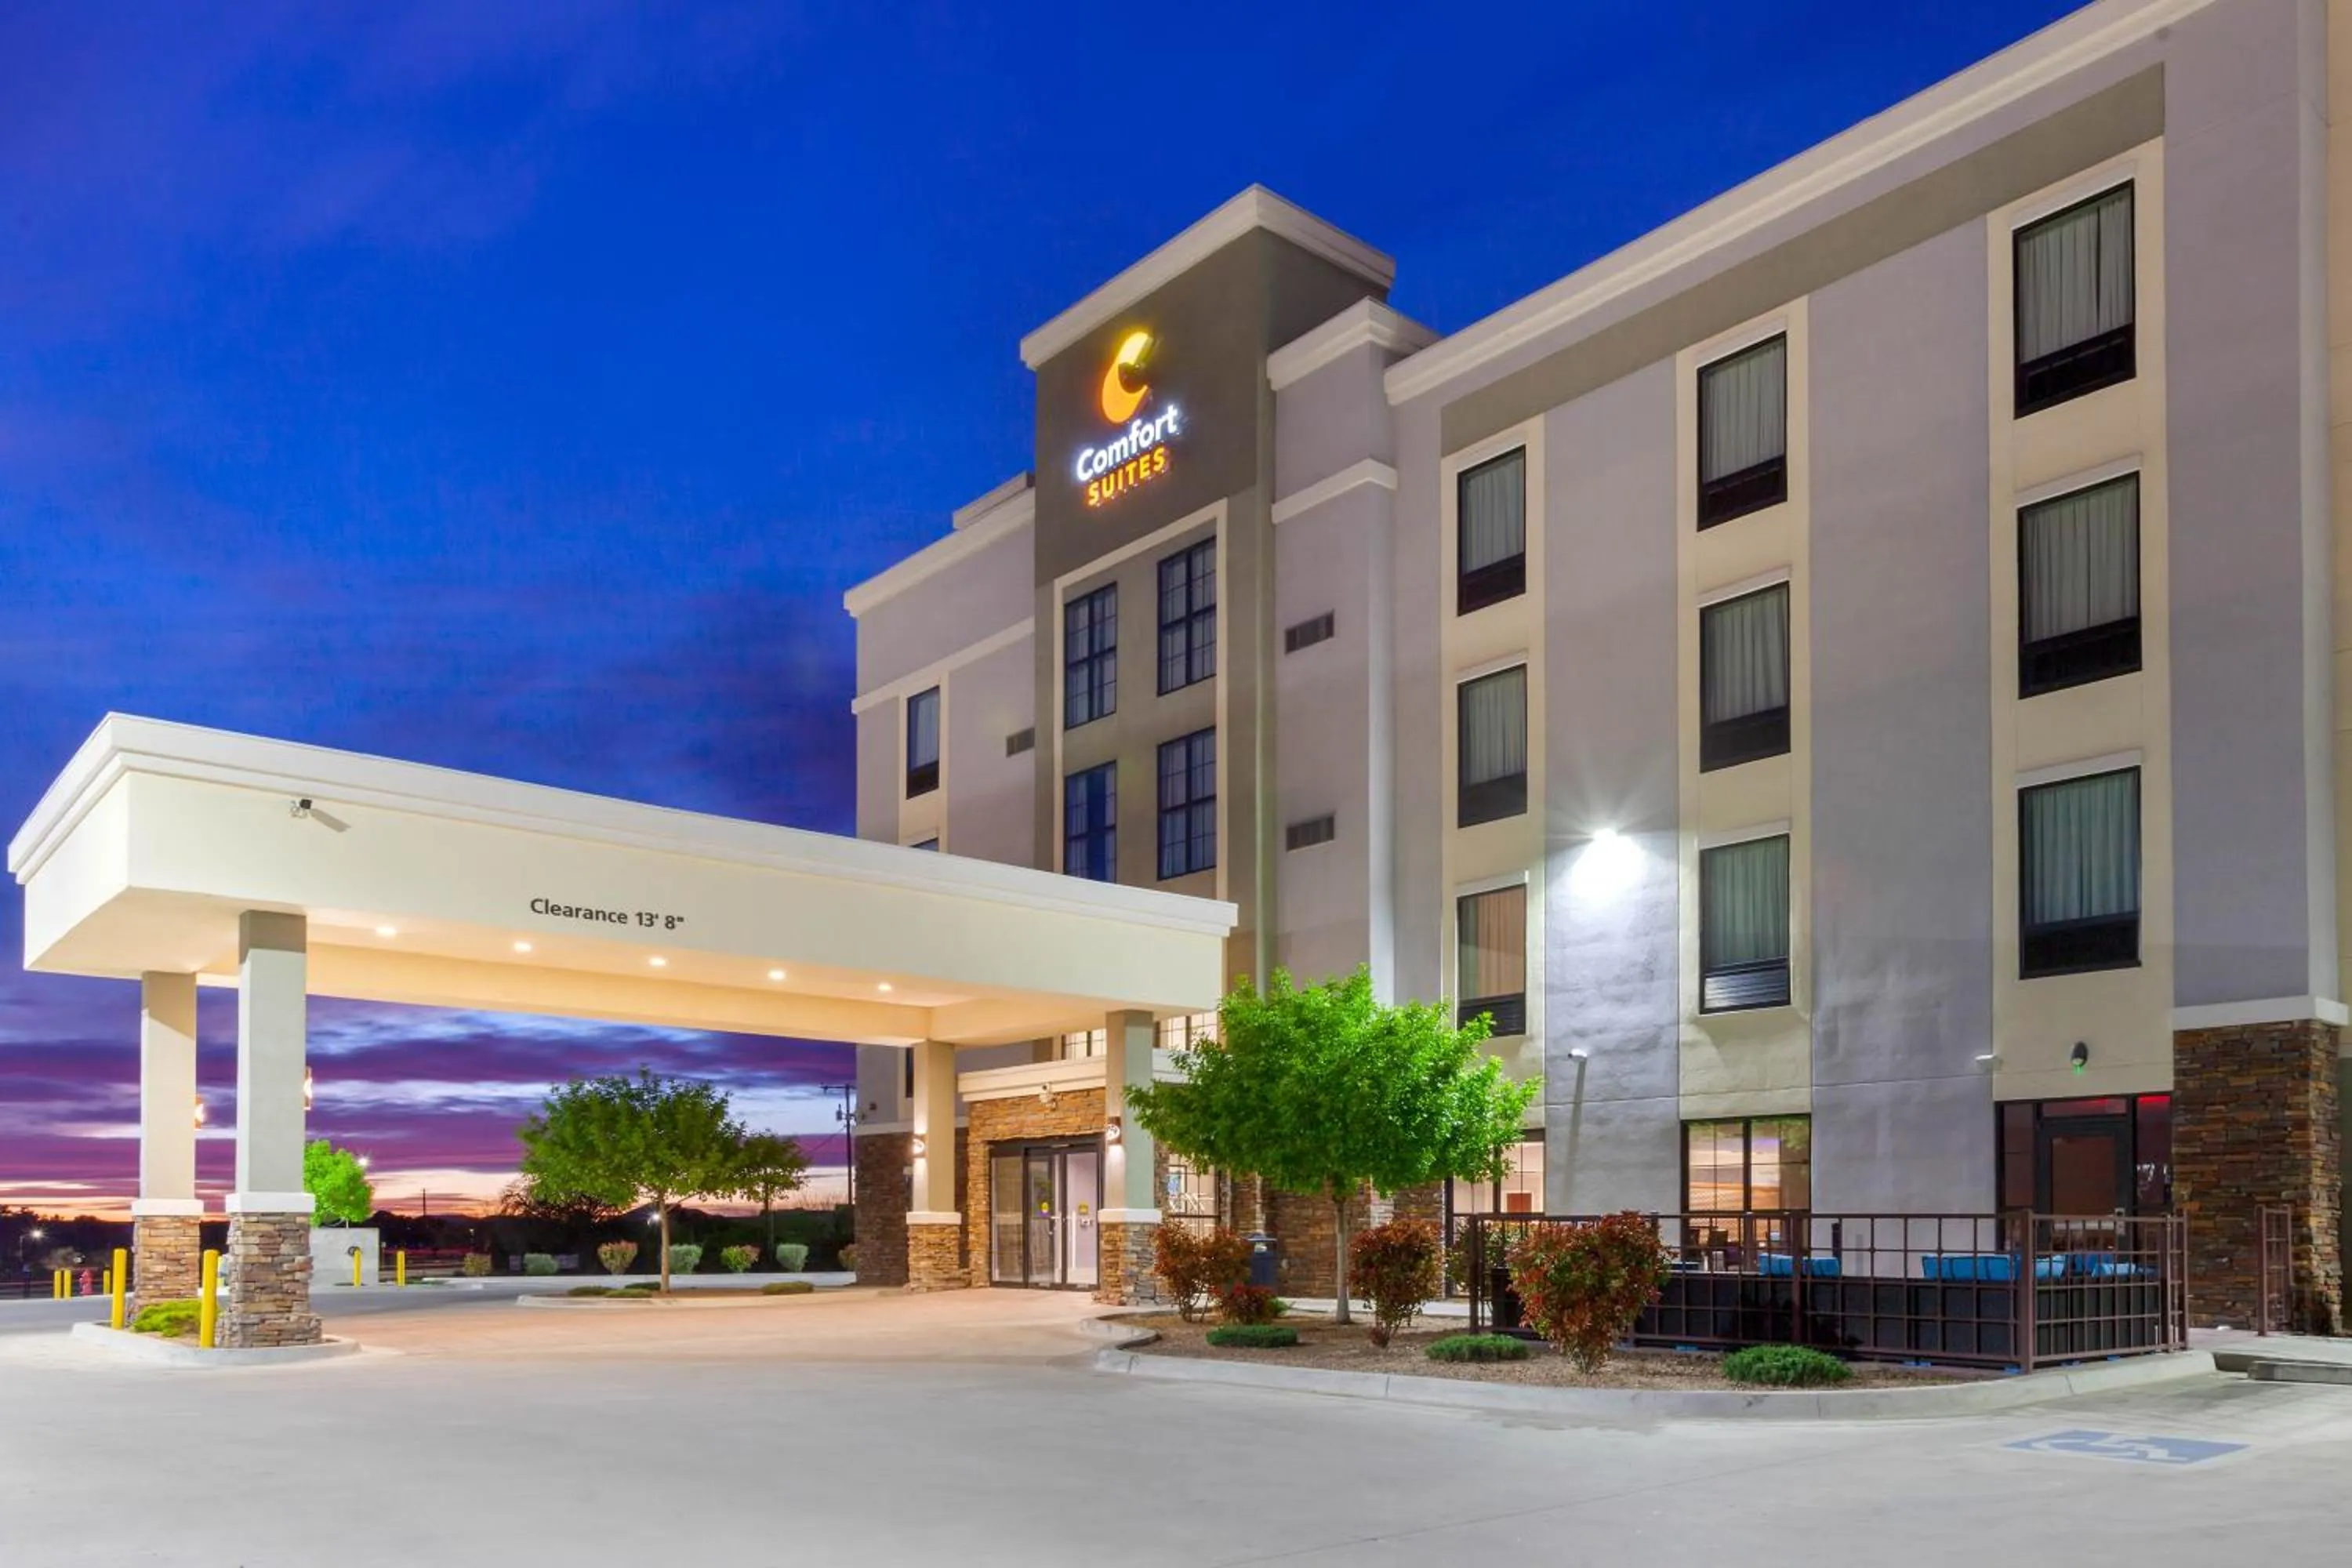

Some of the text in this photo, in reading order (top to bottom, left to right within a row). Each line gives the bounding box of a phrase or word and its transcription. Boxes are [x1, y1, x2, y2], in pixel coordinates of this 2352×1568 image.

[1076, 405, 1178, 481] Comfort
[1088, 447, 1167, 506] SUITES
[530, 898, 628, 924] Clearance
